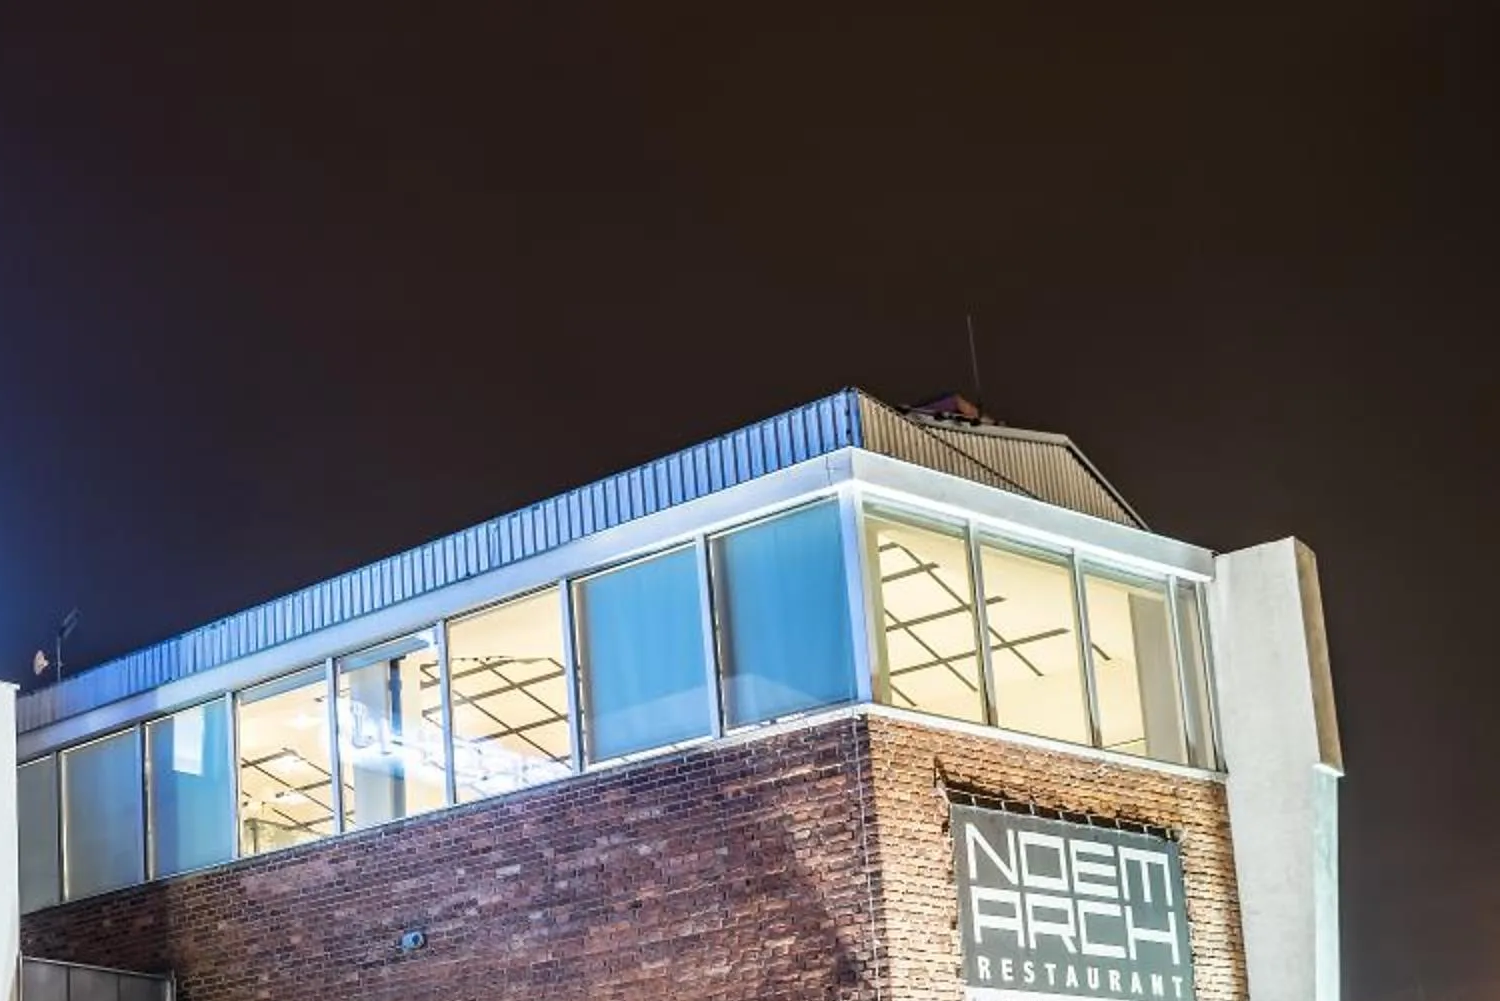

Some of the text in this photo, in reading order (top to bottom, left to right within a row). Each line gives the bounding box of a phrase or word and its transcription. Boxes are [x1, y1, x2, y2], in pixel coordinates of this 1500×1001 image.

[964, 822, 1173, 907] NOEM
[969, 885, 1181, 965] ARCH
[976, 955, 1186, 999] RESTAURANT
